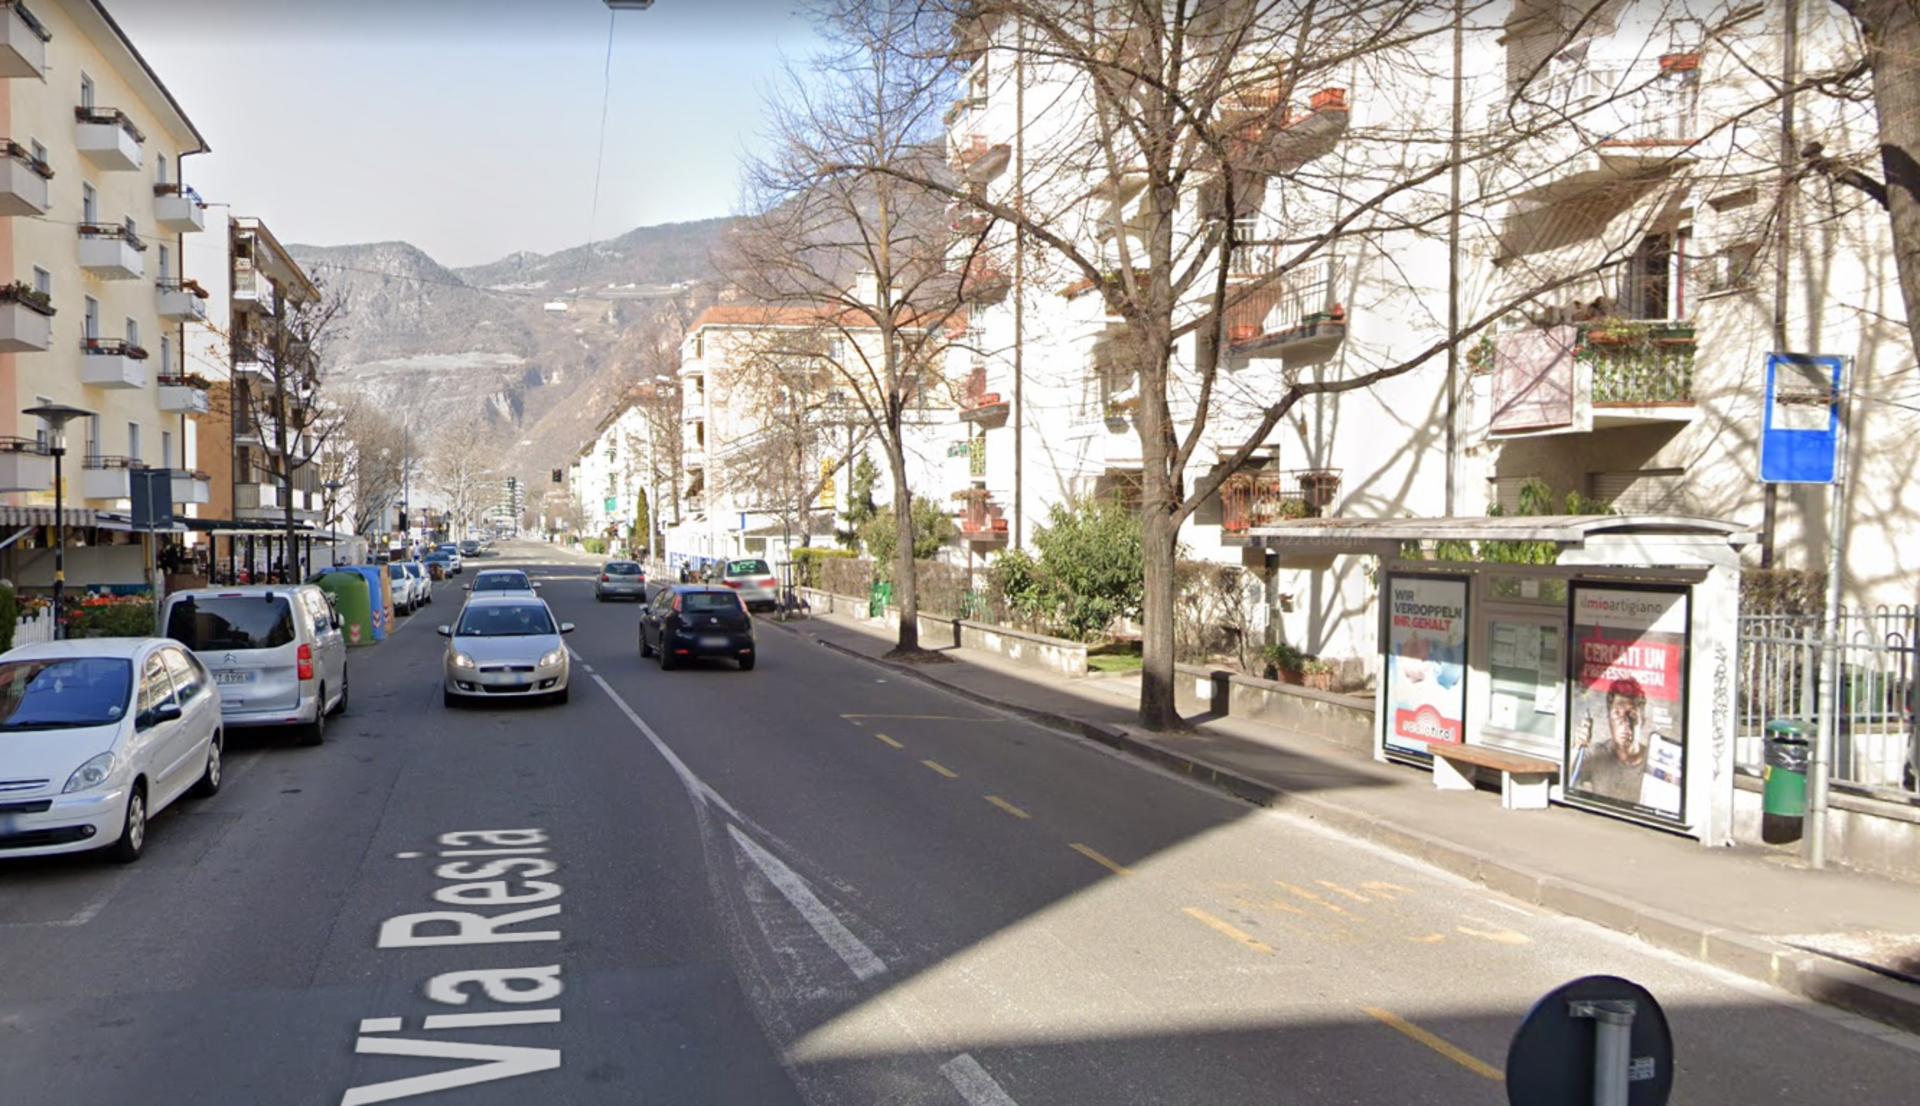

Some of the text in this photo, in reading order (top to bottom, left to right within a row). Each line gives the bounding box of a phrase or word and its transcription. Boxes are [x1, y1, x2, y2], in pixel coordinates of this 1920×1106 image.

[1394, 589, 1414, 602] WIR
[1394, 602, 1463, 618] VERDOPPELN
[1580, 597, 1663, 616] ilmioartigiano
[1411, 616, 1452, 632] GEHALT
[1584, 643, 1666, 671] CERCATI UN
